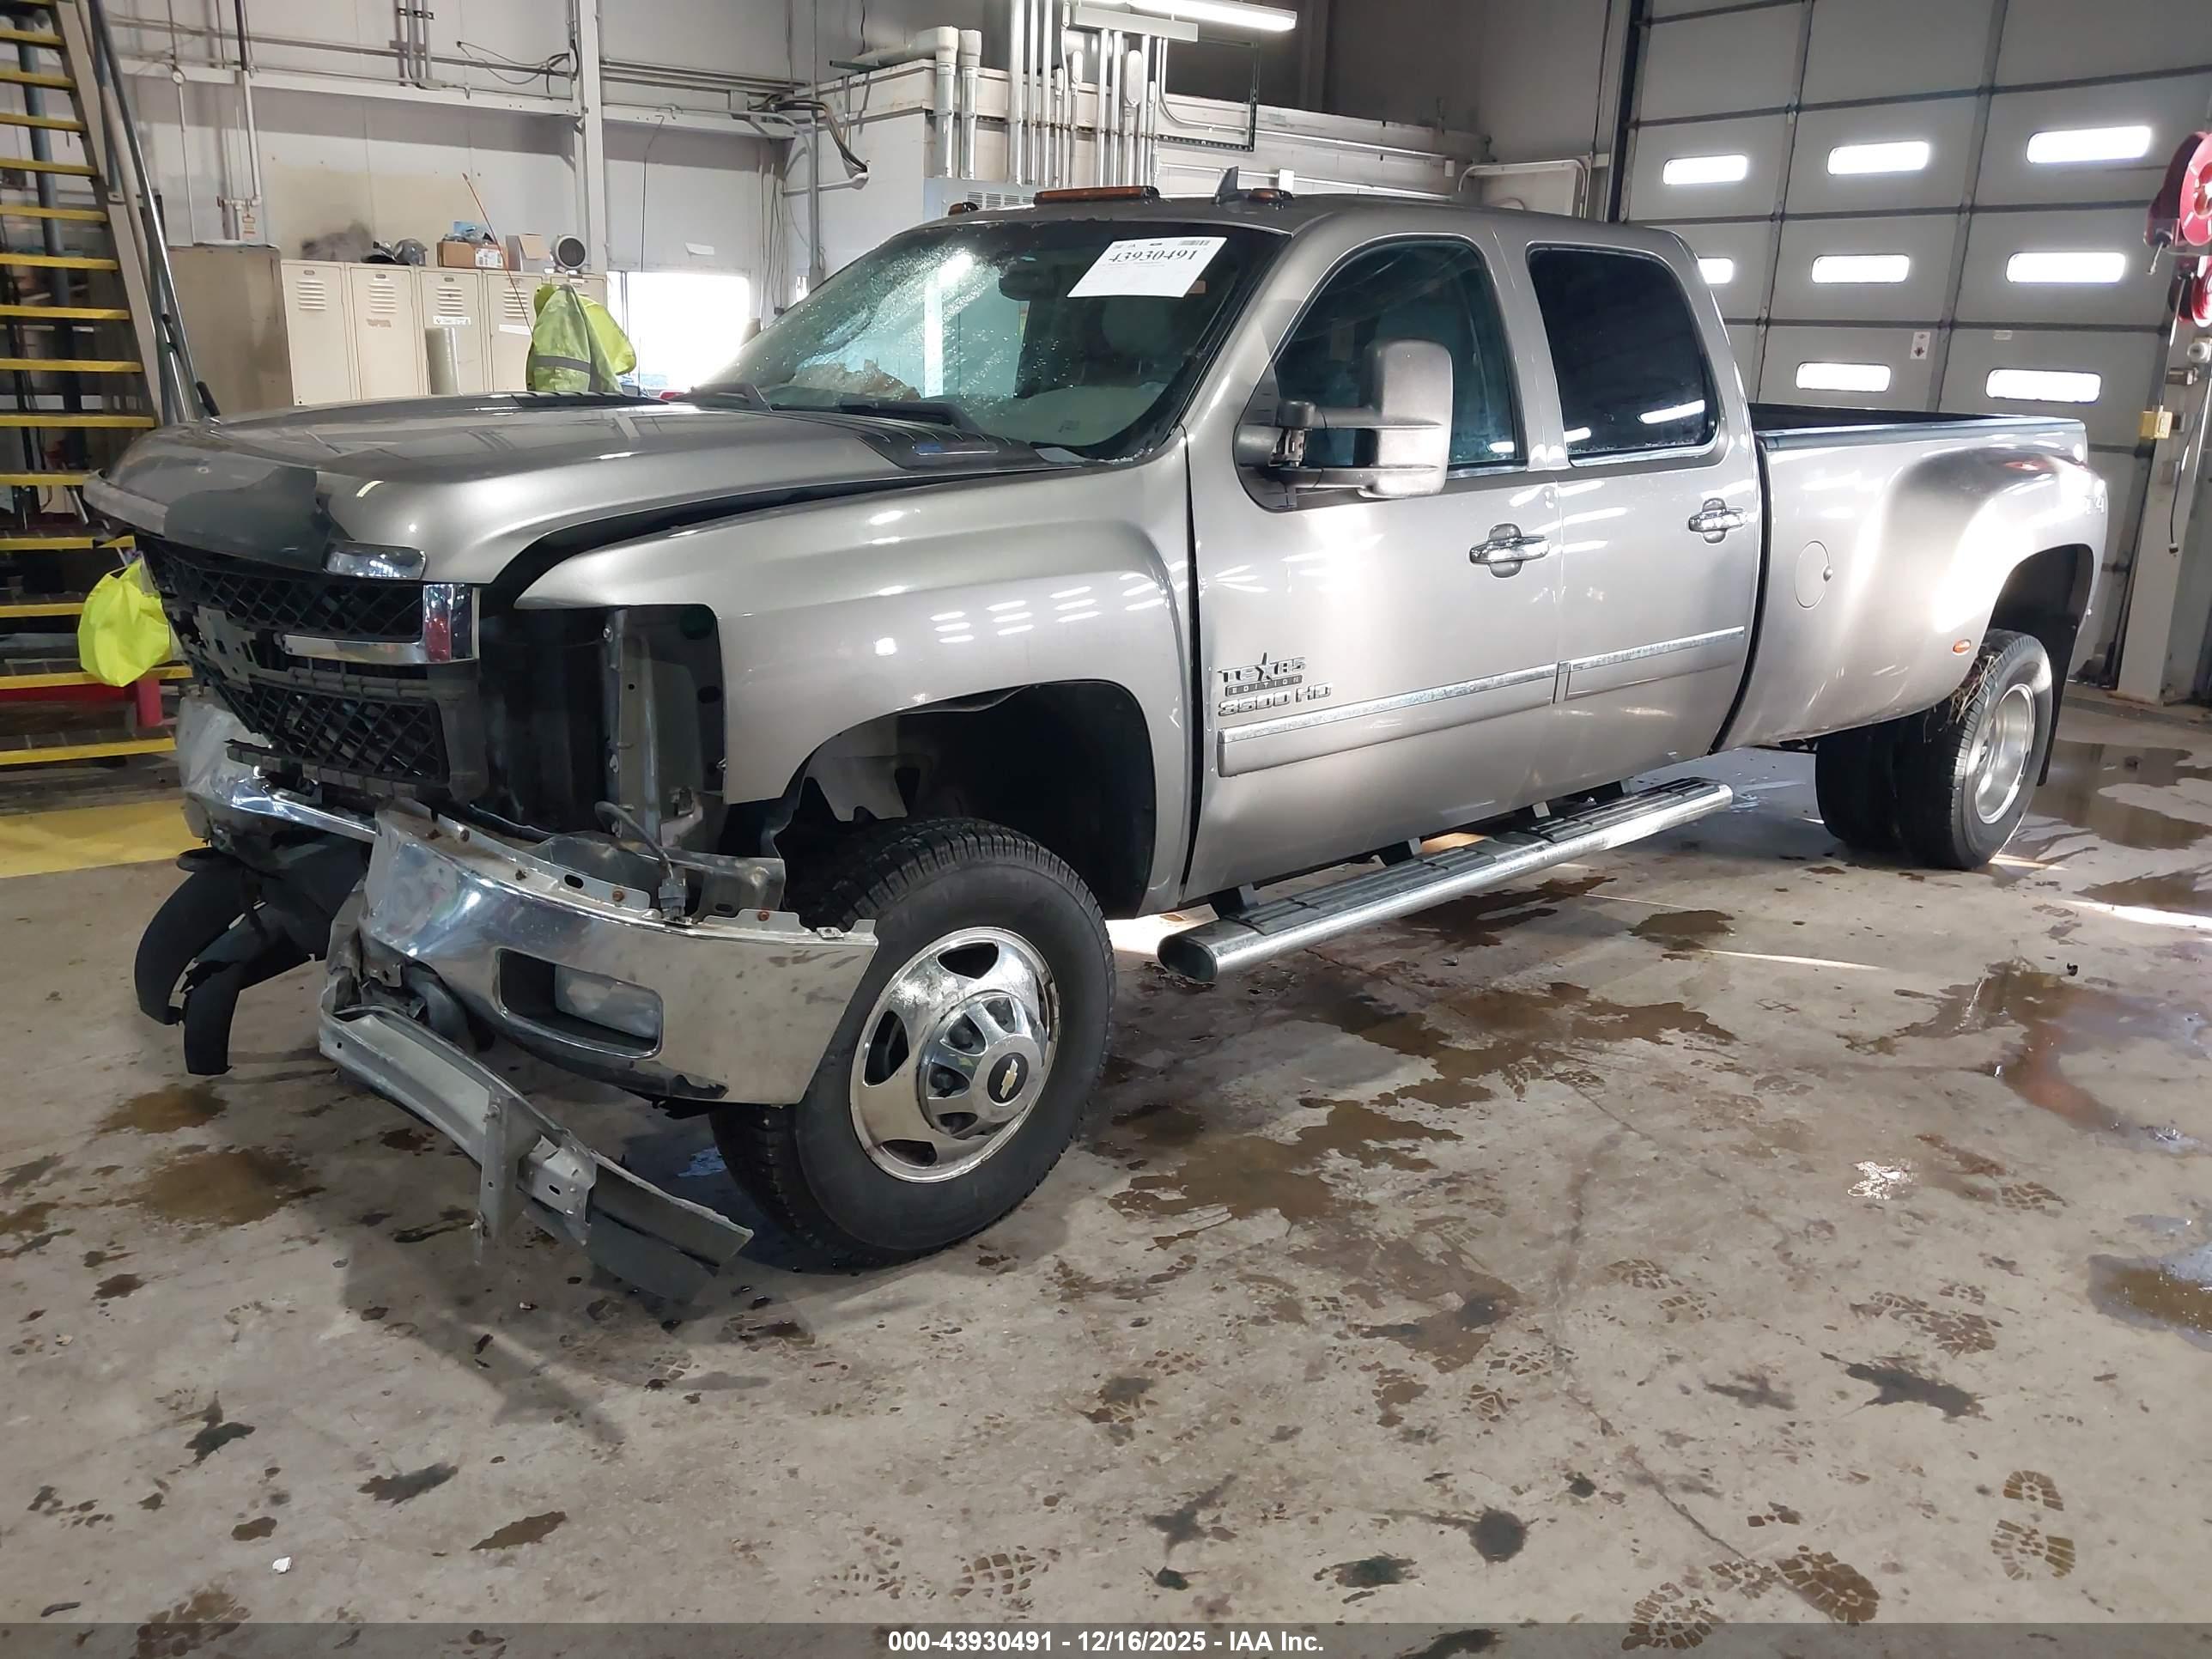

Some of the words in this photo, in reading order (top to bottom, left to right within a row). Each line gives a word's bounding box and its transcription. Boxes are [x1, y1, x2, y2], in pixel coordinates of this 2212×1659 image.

[1109, 249, 1198, 263] 43930491
[1218, 653, 1306, 684] TEXAS
[1231, 678, 1300, 694] EDITION
[1218, 691, 1291, 716] 3500
[1295, 683, 1333, 702] HD
